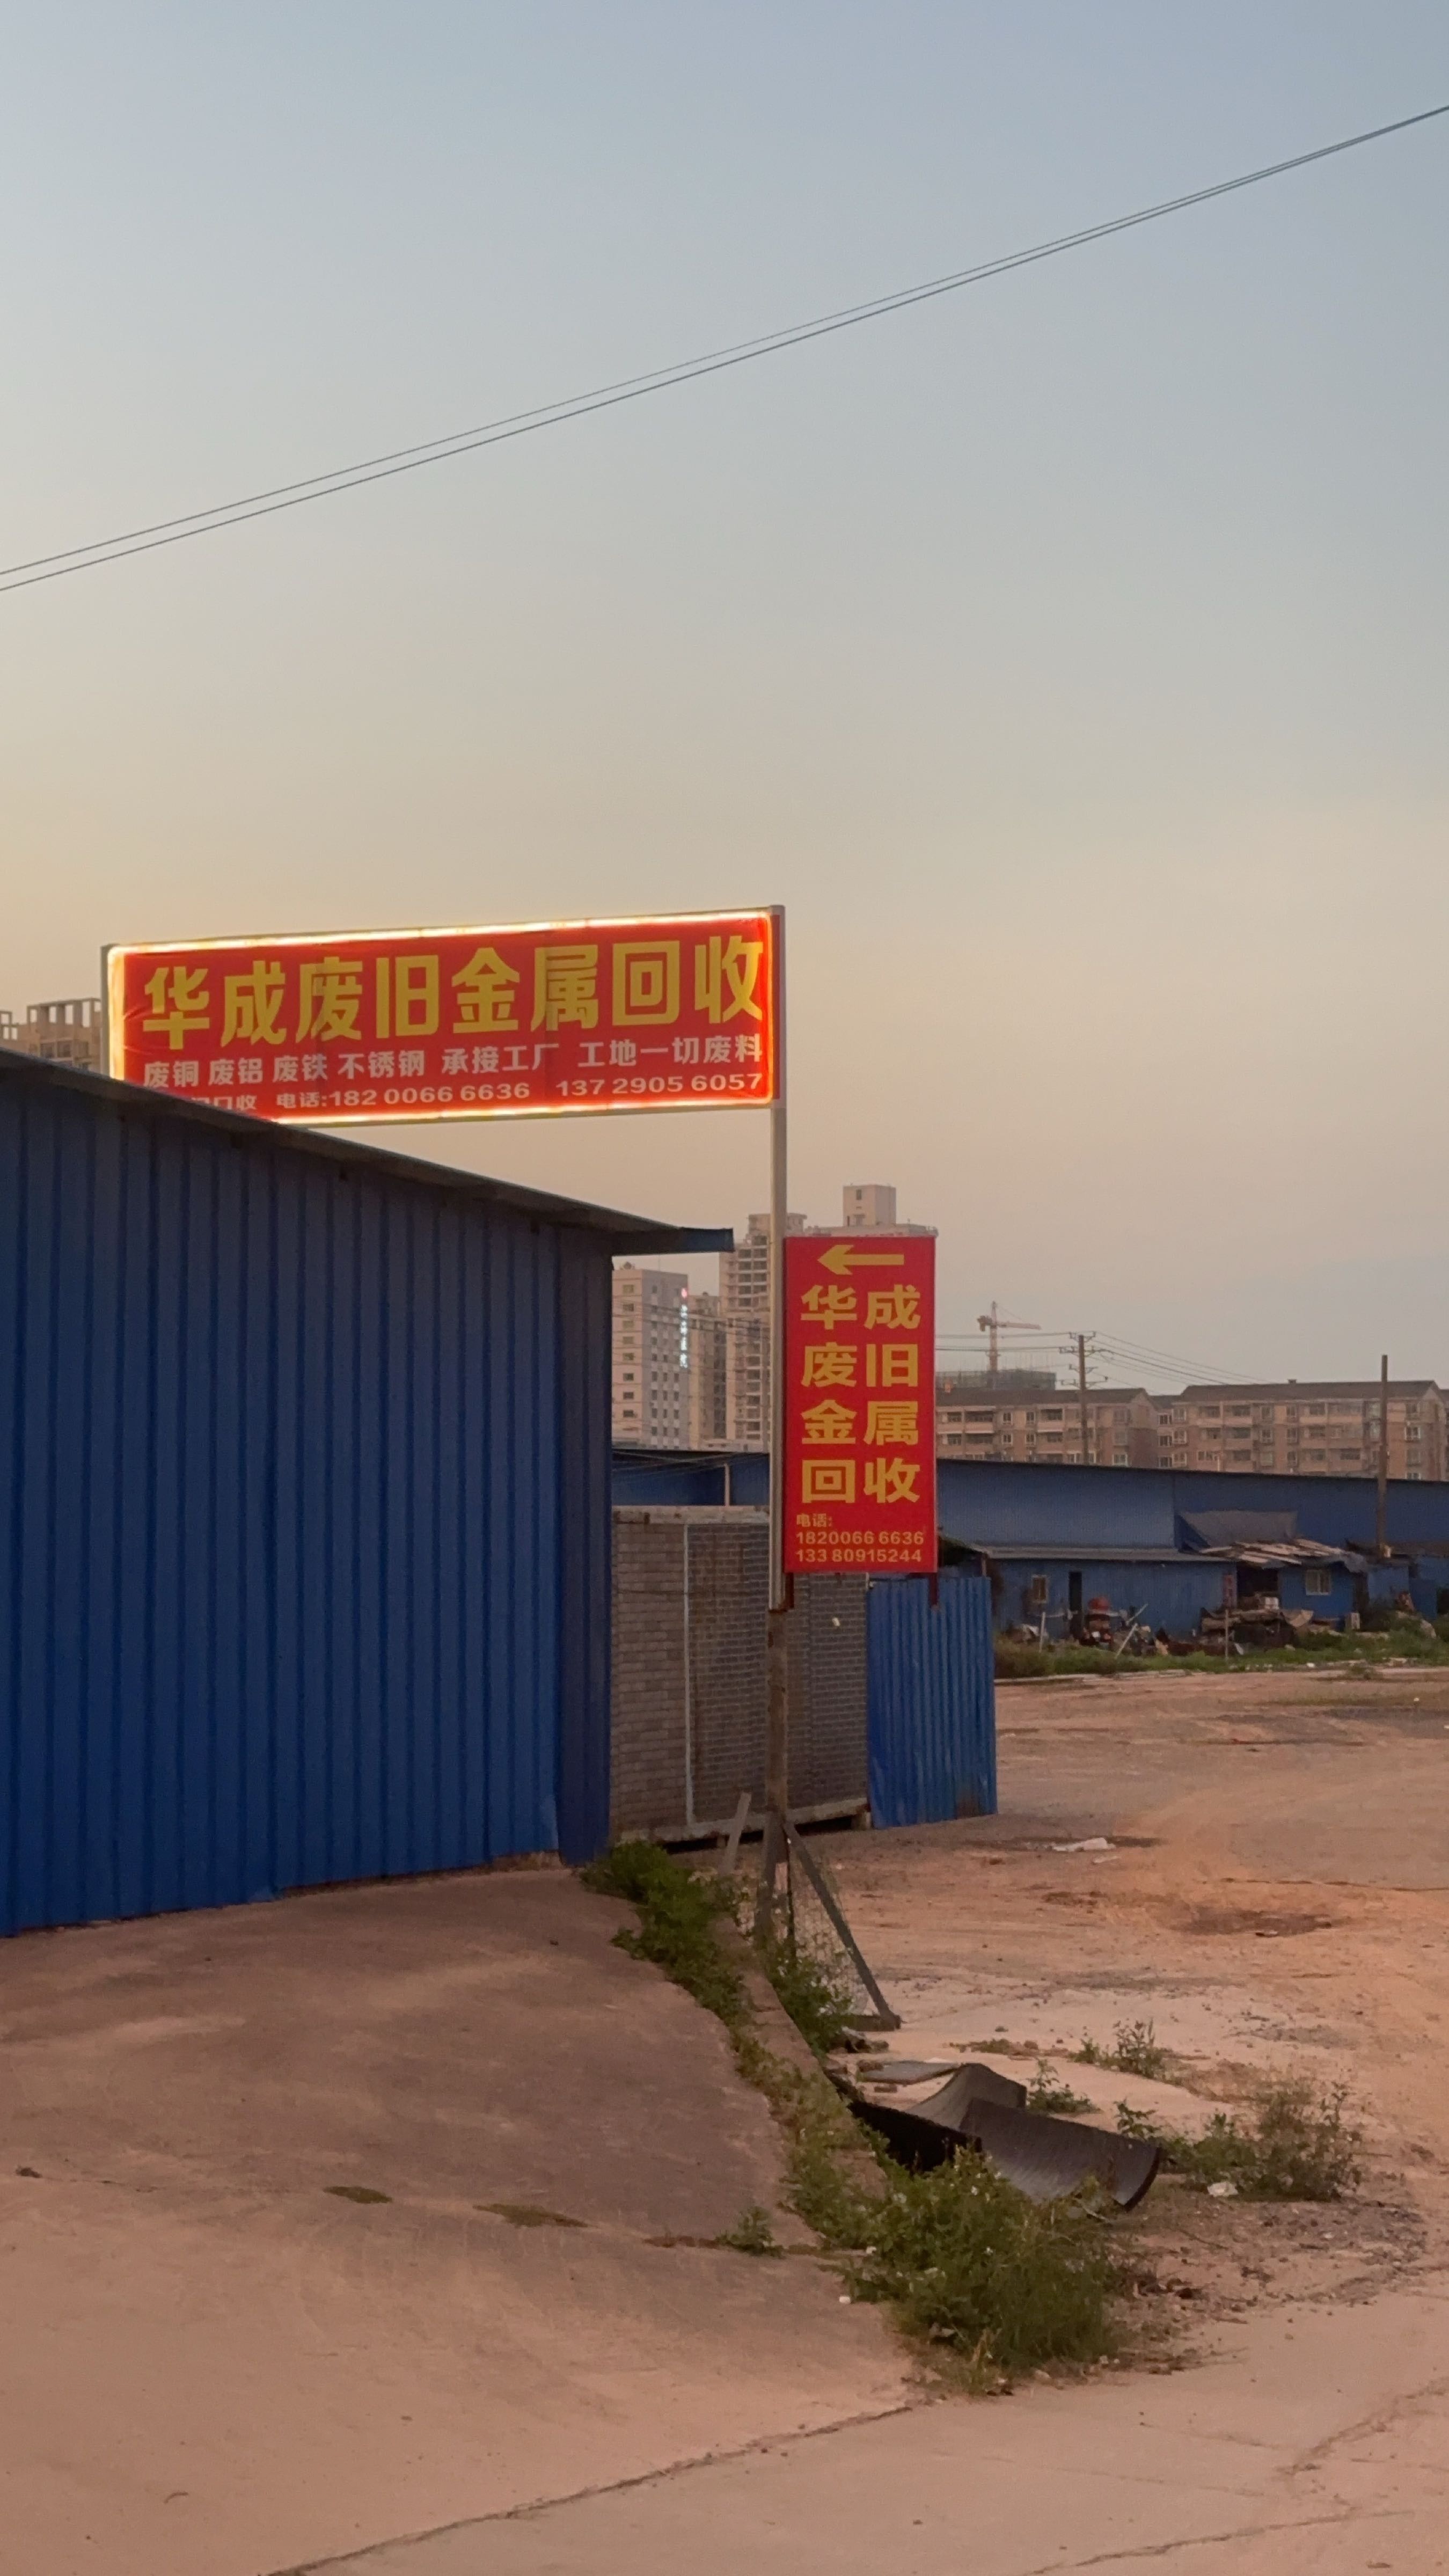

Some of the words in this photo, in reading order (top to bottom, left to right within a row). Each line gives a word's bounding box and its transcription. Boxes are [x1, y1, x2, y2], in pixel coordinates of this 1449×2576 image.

[143, 935, 763, 1050] 华成废旧金属回收
[144, 1060, 199, 1088] 废铜
[208, 1058, 263, 1085] 废铝
[273, 1053, 328, 1082] 废铁
[338, 1050, 425, 1079] 不锈钢
[442, 1043, 559, 1074] 承接工厂
[578, 1033, 763, 1067] 工地一切废料
[384, 1086, 453, 1104] 0066
[460, 1082, 530, 1101] 6636
[556, 1079, 605, 1096] 137
[612, 1076, 683, 1094] 2905
[691, 1073, 763, 1092] 6057
[801, 1285, 921, 1330] 华成
[801, 1342, 919, 1387] 废旧
[801, 1400, 919, 1445] 金属
[802, 1458, 921, 1503] 回收
[879, 1531, 924, 1545] 6636
